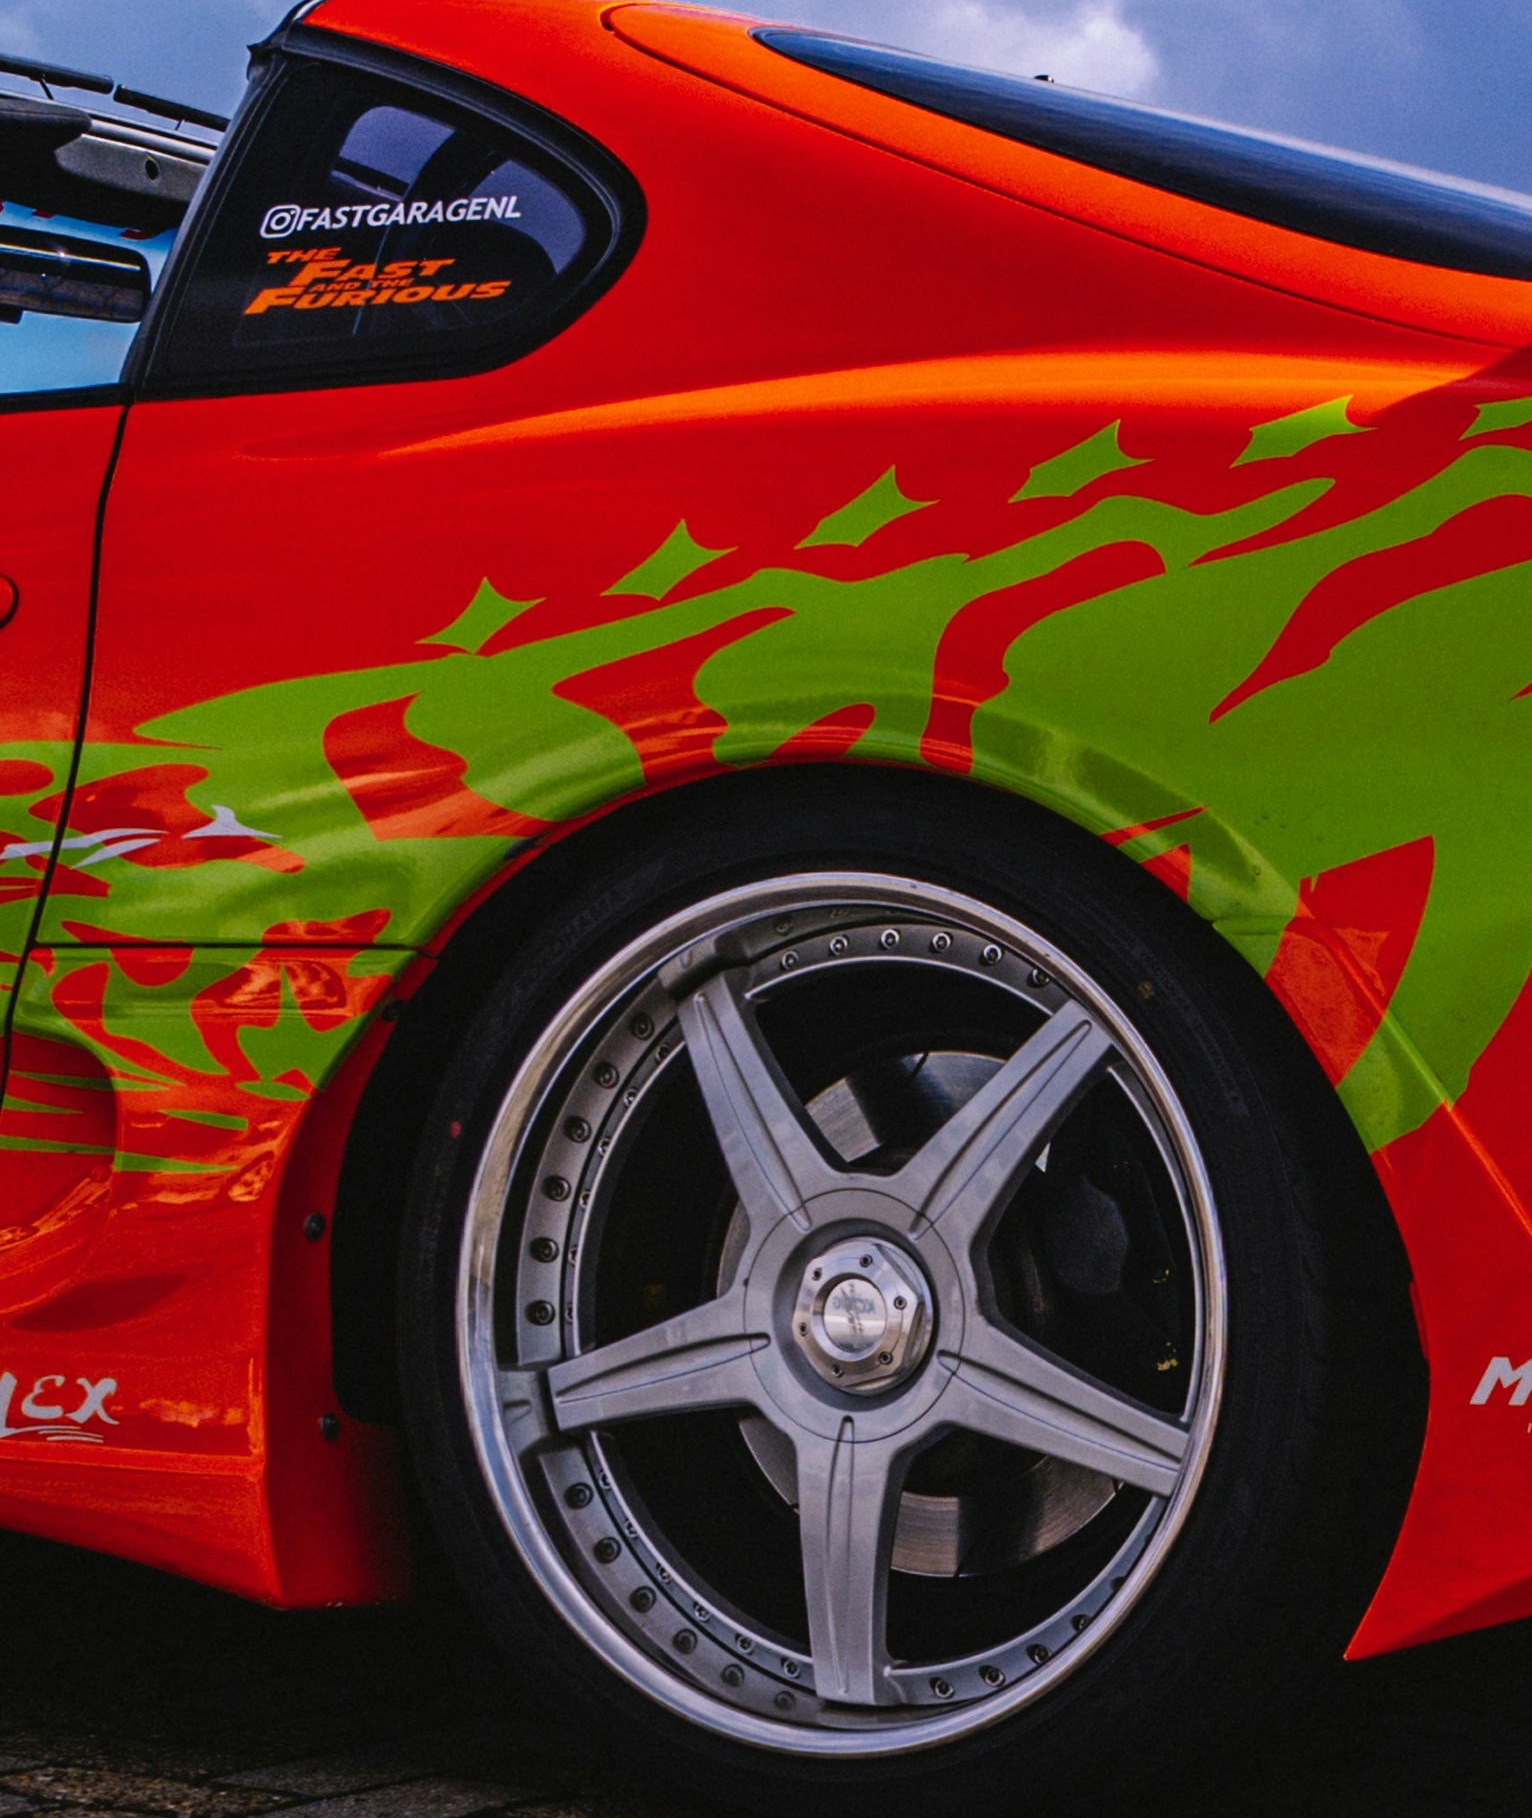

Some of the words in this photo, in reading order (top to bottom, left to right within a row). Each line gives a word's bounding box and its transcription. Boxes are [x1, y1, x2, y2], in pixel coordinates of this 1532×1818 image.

[297, 196, 521, 231] FASTGARAGENL
[267, 247, 341, 264] THE
[243, 280, 511, 315] FURIOUS
[310, 281, 364, 292] AND
[369, 277, 415, 287] THE
